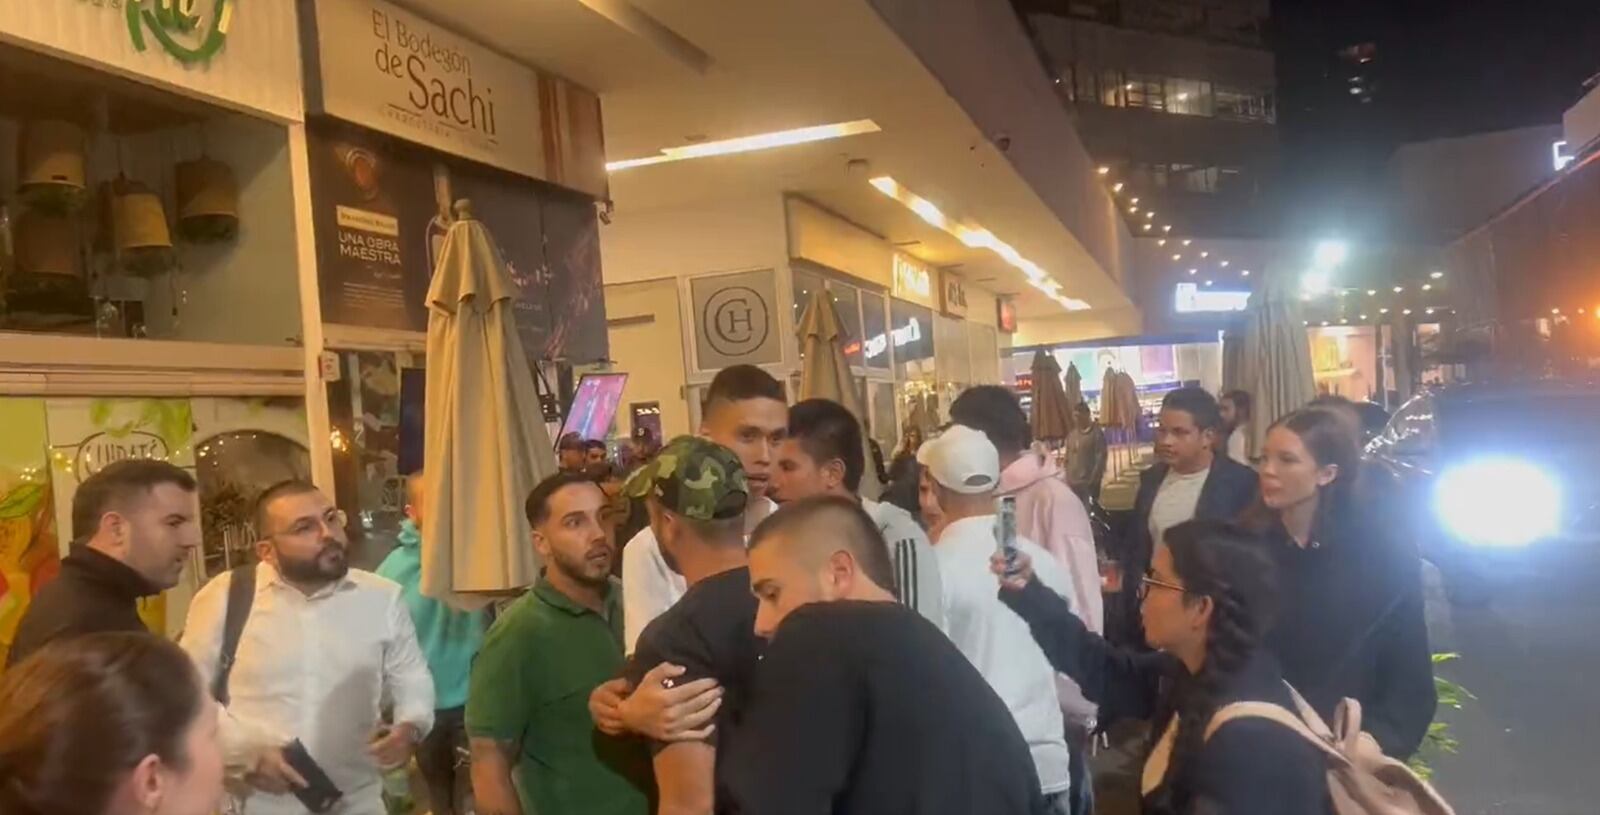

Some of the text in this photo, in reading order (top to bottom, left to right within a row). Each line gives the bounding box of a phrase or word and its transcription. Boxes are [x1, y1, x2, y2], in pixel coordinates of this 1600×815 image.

[372, 8, 389, 41] El
[375, 42, 403, 78] de
[407, 54, 495, 135] Sachi
[338, 230, 399, 252] UNA OBRA
[340, 243, 402, 265] MAESTRA
